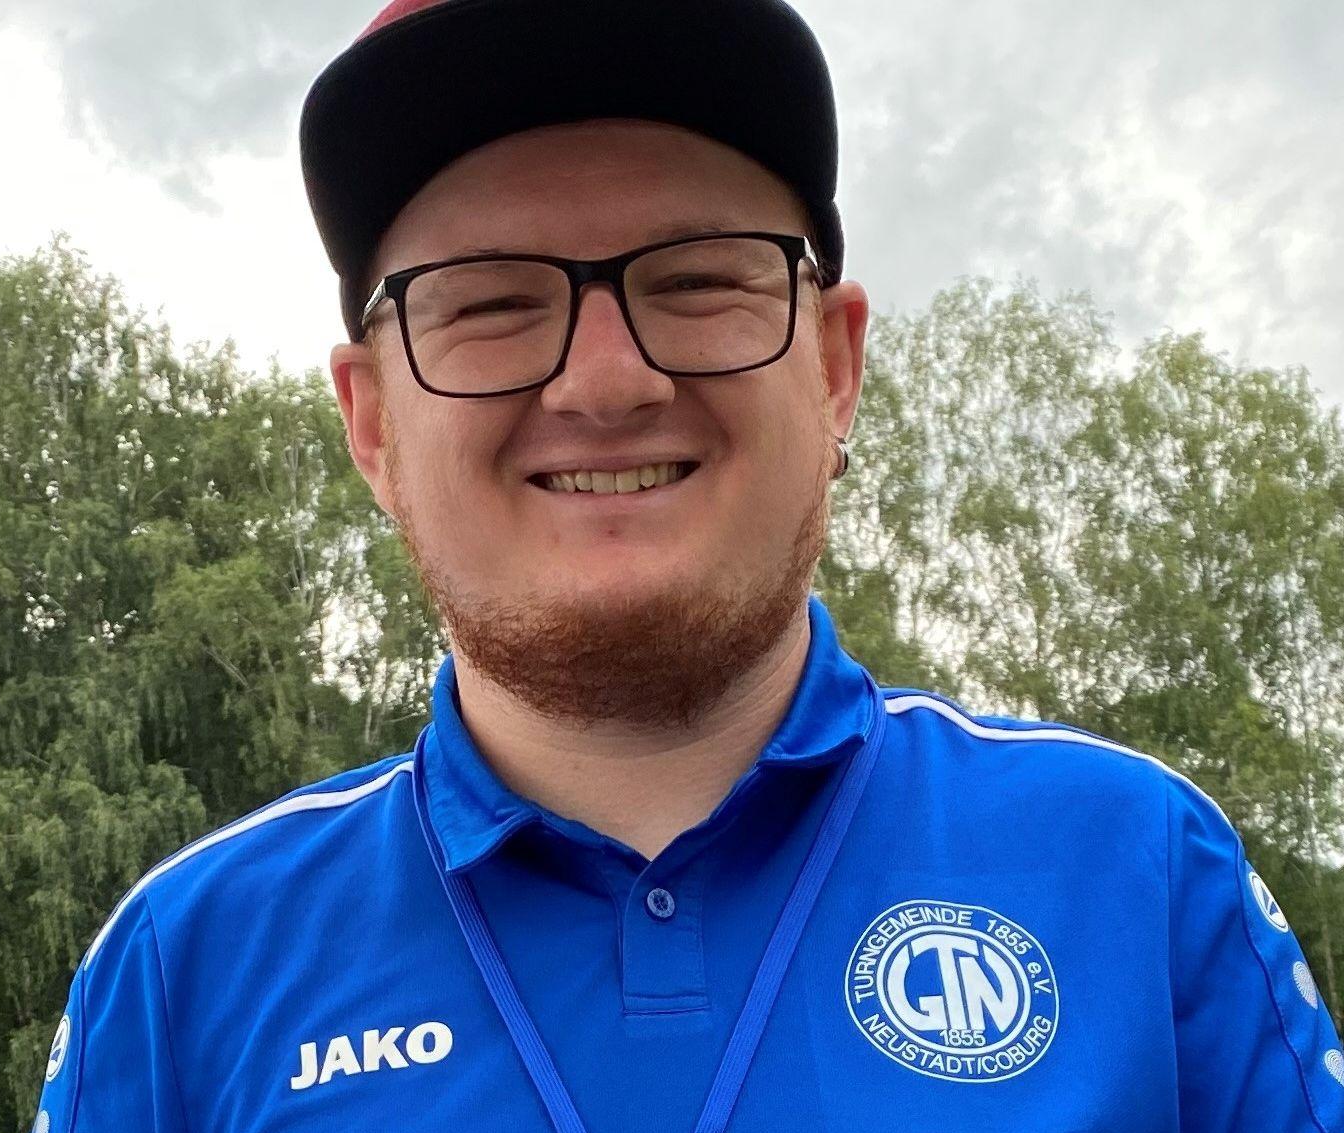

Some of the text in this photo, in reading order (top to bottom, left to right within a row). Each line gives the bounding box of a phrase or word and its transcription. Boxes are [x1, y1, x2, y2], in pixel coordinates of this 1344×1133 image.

[854, 906, 1052, 1004] TURNGEMEINDE 1855 e.V.
[290, 1021, 454, 1090] JAKO
[863, 1013, 1052, 1075] NEUSTADT/COBURG
[940, 1029, 986, 1046] 1855
